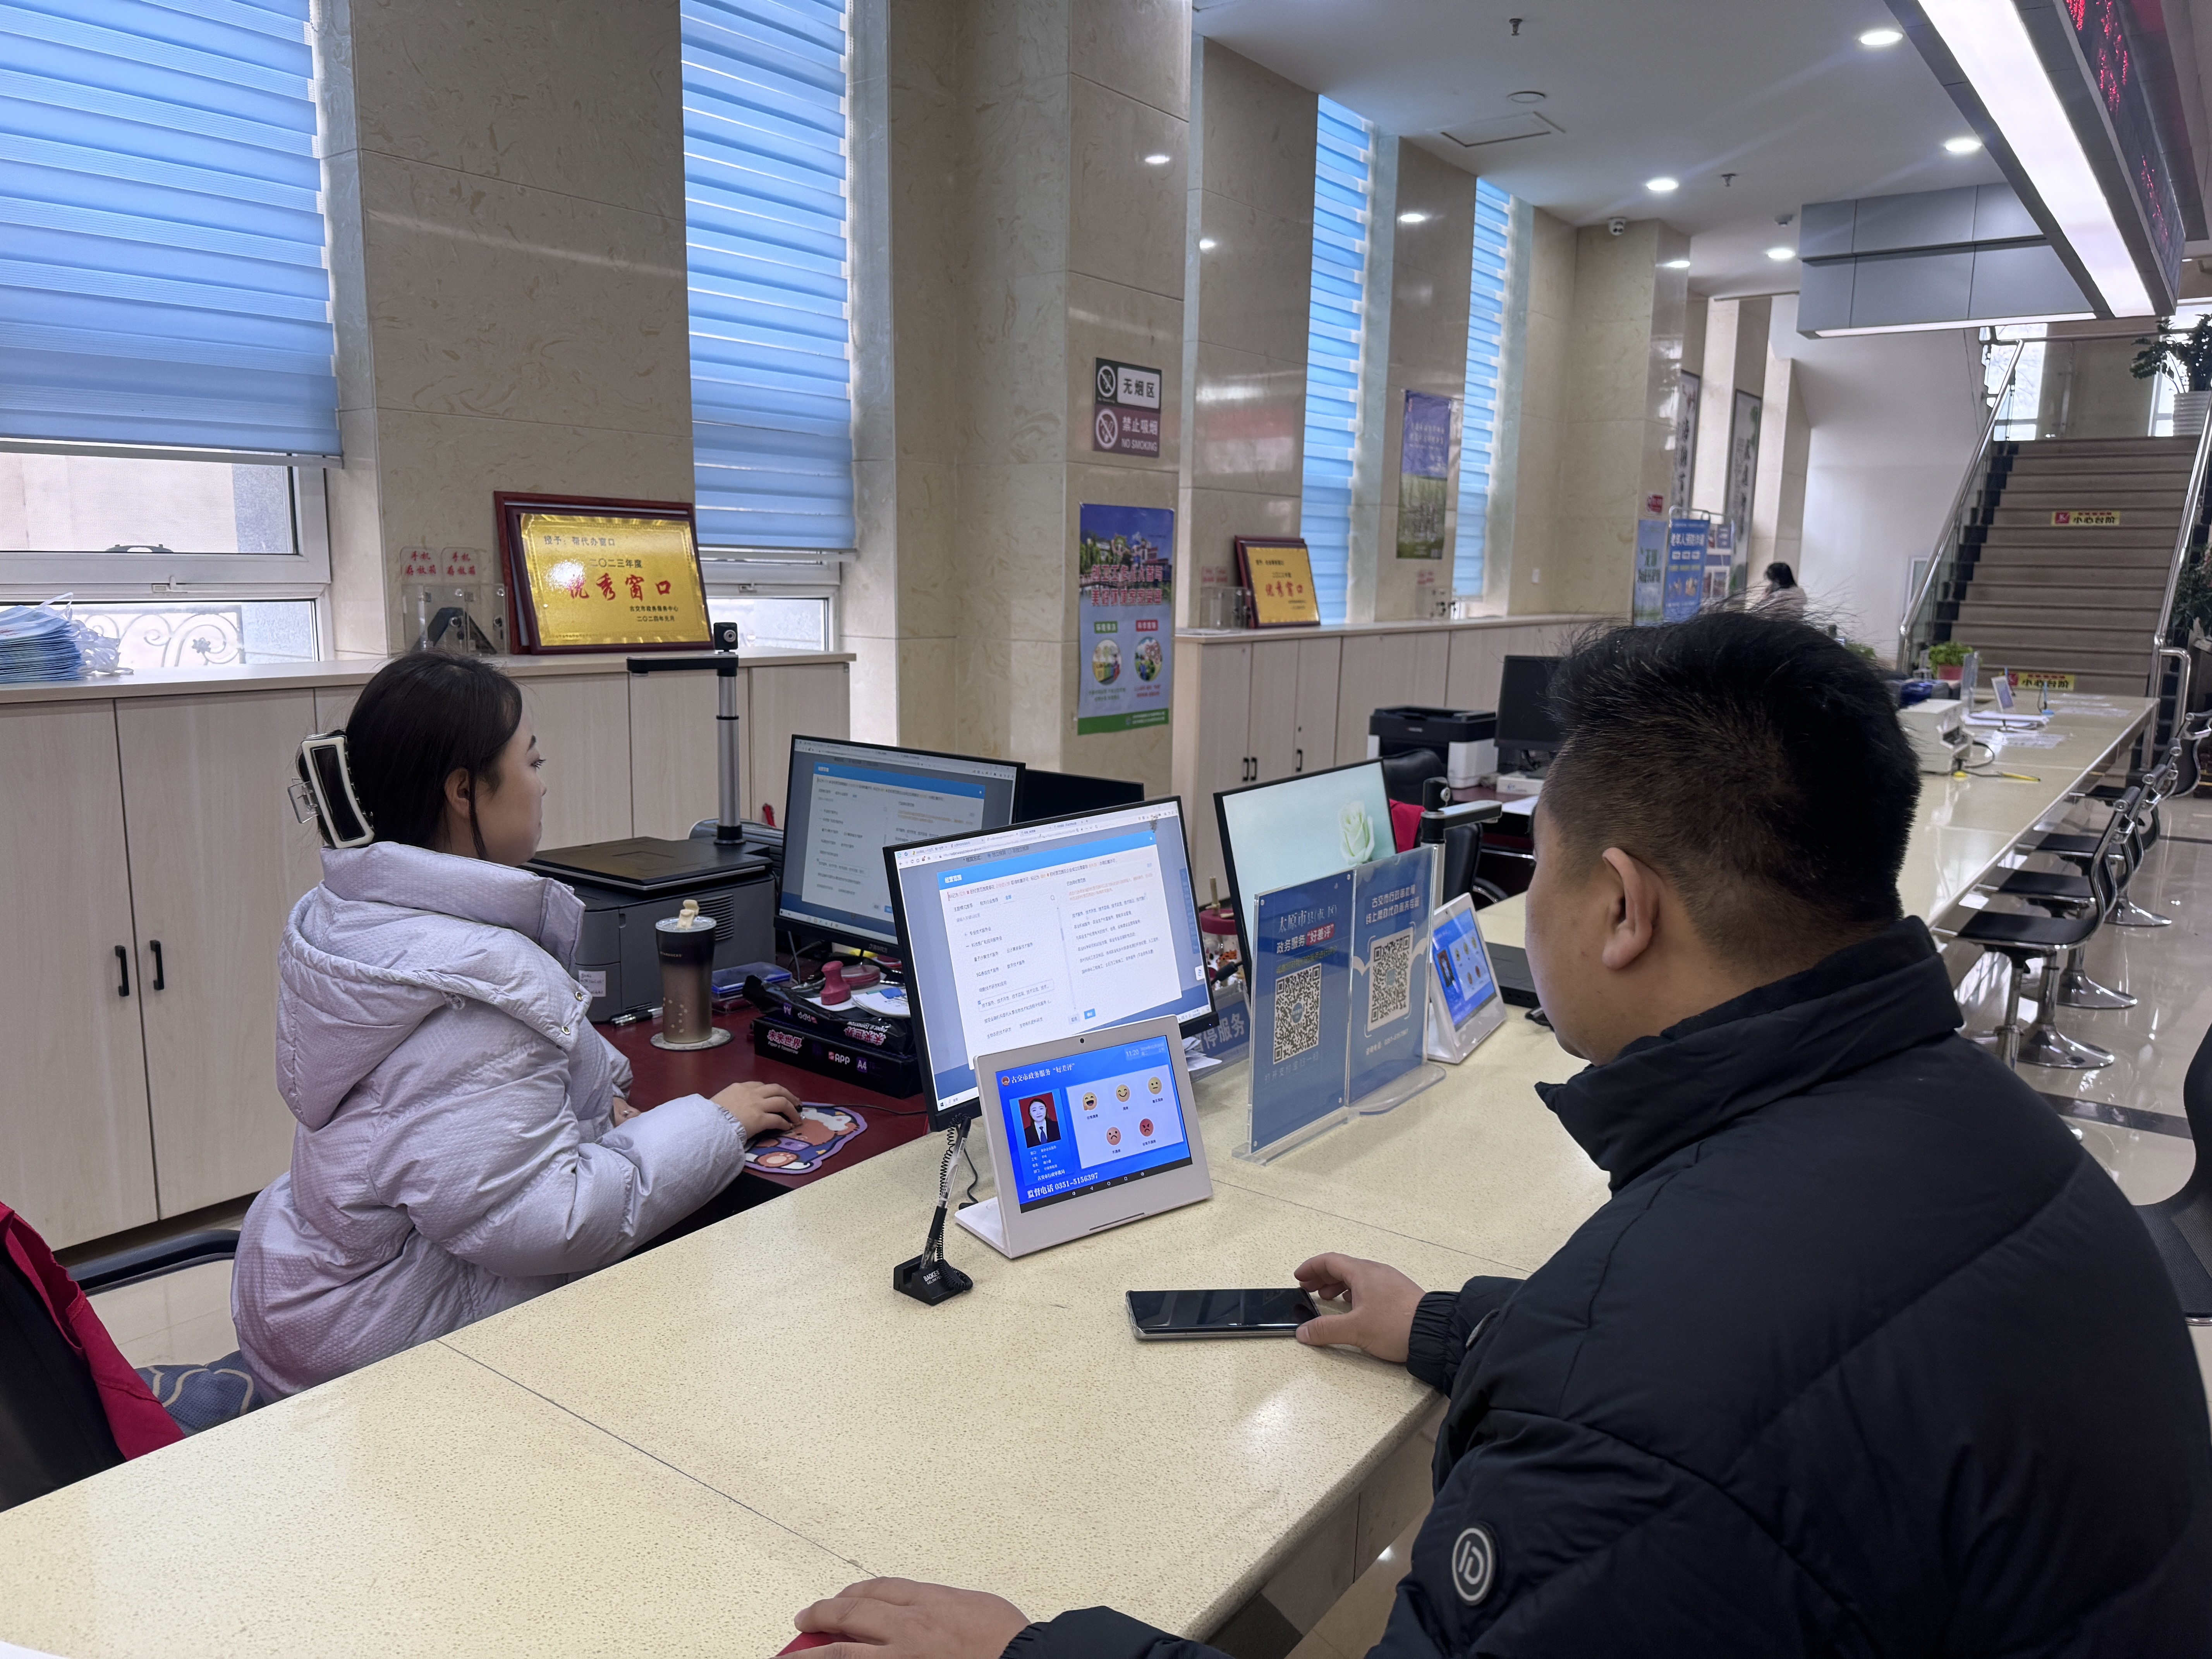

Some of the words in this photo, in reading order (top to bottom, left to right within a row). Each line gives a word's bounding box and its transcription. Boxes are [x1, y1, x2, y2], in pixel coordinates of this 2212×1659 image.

[1123, 378, 1154, 398] 无烟区
[1122, 416, 1158, 436] 禁止吸烟
[1121, 438, 1130, 448] NO
[1132, 440, 1158, 452] SMOKING
[567, 573, 672, 601] 优秀窗口
[1276, 935, 1305, 954] 政务服务
[767, 1029, 802, 1050] 未来世界
[1126, 1048, 1139, 1057] 11:20
[857, 1060, 867, 1070] A4
[1027, 1183, 1054, 1199] 监督电话
[1054, 1172, 1099, 1190] 0351-5156397
